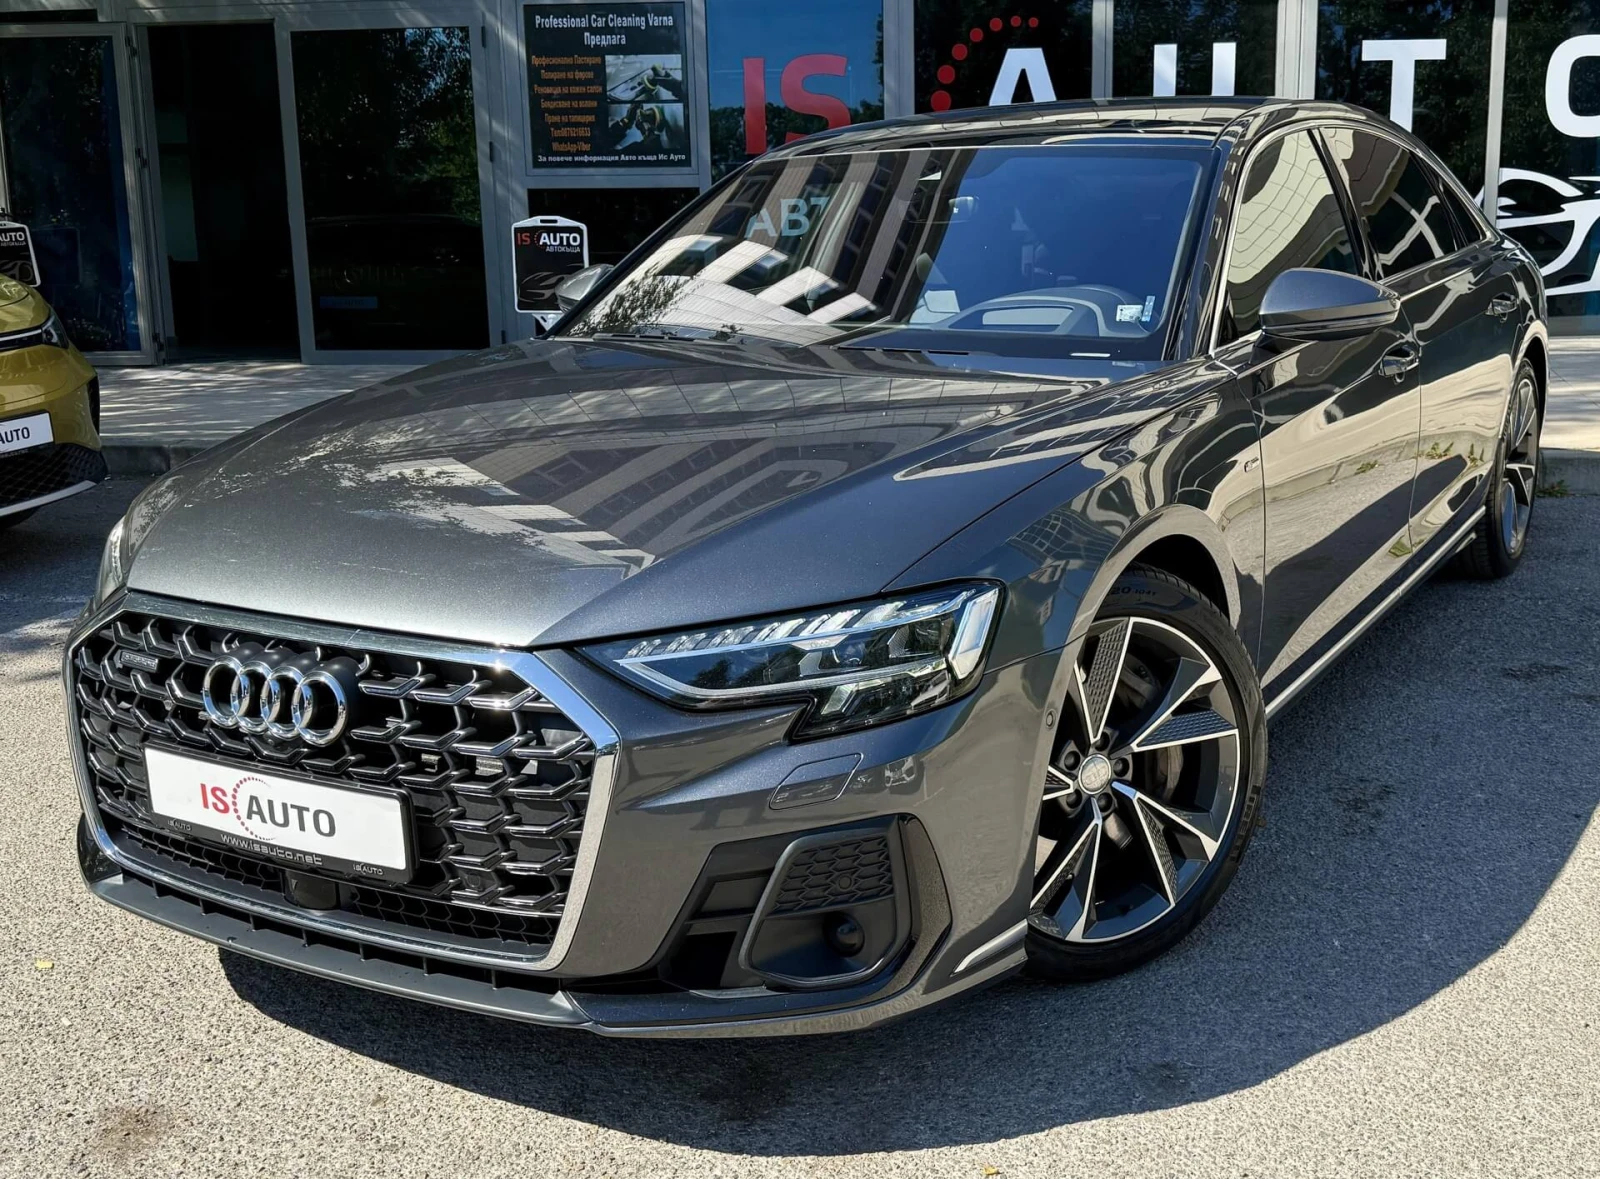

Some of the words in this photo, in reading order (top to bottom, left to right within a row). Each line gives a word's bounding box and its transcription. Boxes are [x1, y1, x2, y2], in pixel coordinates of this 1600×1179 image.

[535, 14, 589, 28] Professional
[591, 14, 606, 27] Car
[608, 13, 646, 30] Cleaning
[647, 13, 674, 27] Varna
[584, 31, 626, 48] Предлага
[743, 53, 851, 154] IS
[574, 154, 619, 163] информация
[669, 153, 686, 162] Ауто
[517, 232, 531, 245] IS
[540, 232, 581, 246] AUTO
[200, 782, 230, 815] IS
[246, 794, 336, 838] AUTO
[220, 833, 323, 866] www.isauto.net
[362, 865, 383, 876] AUTO
